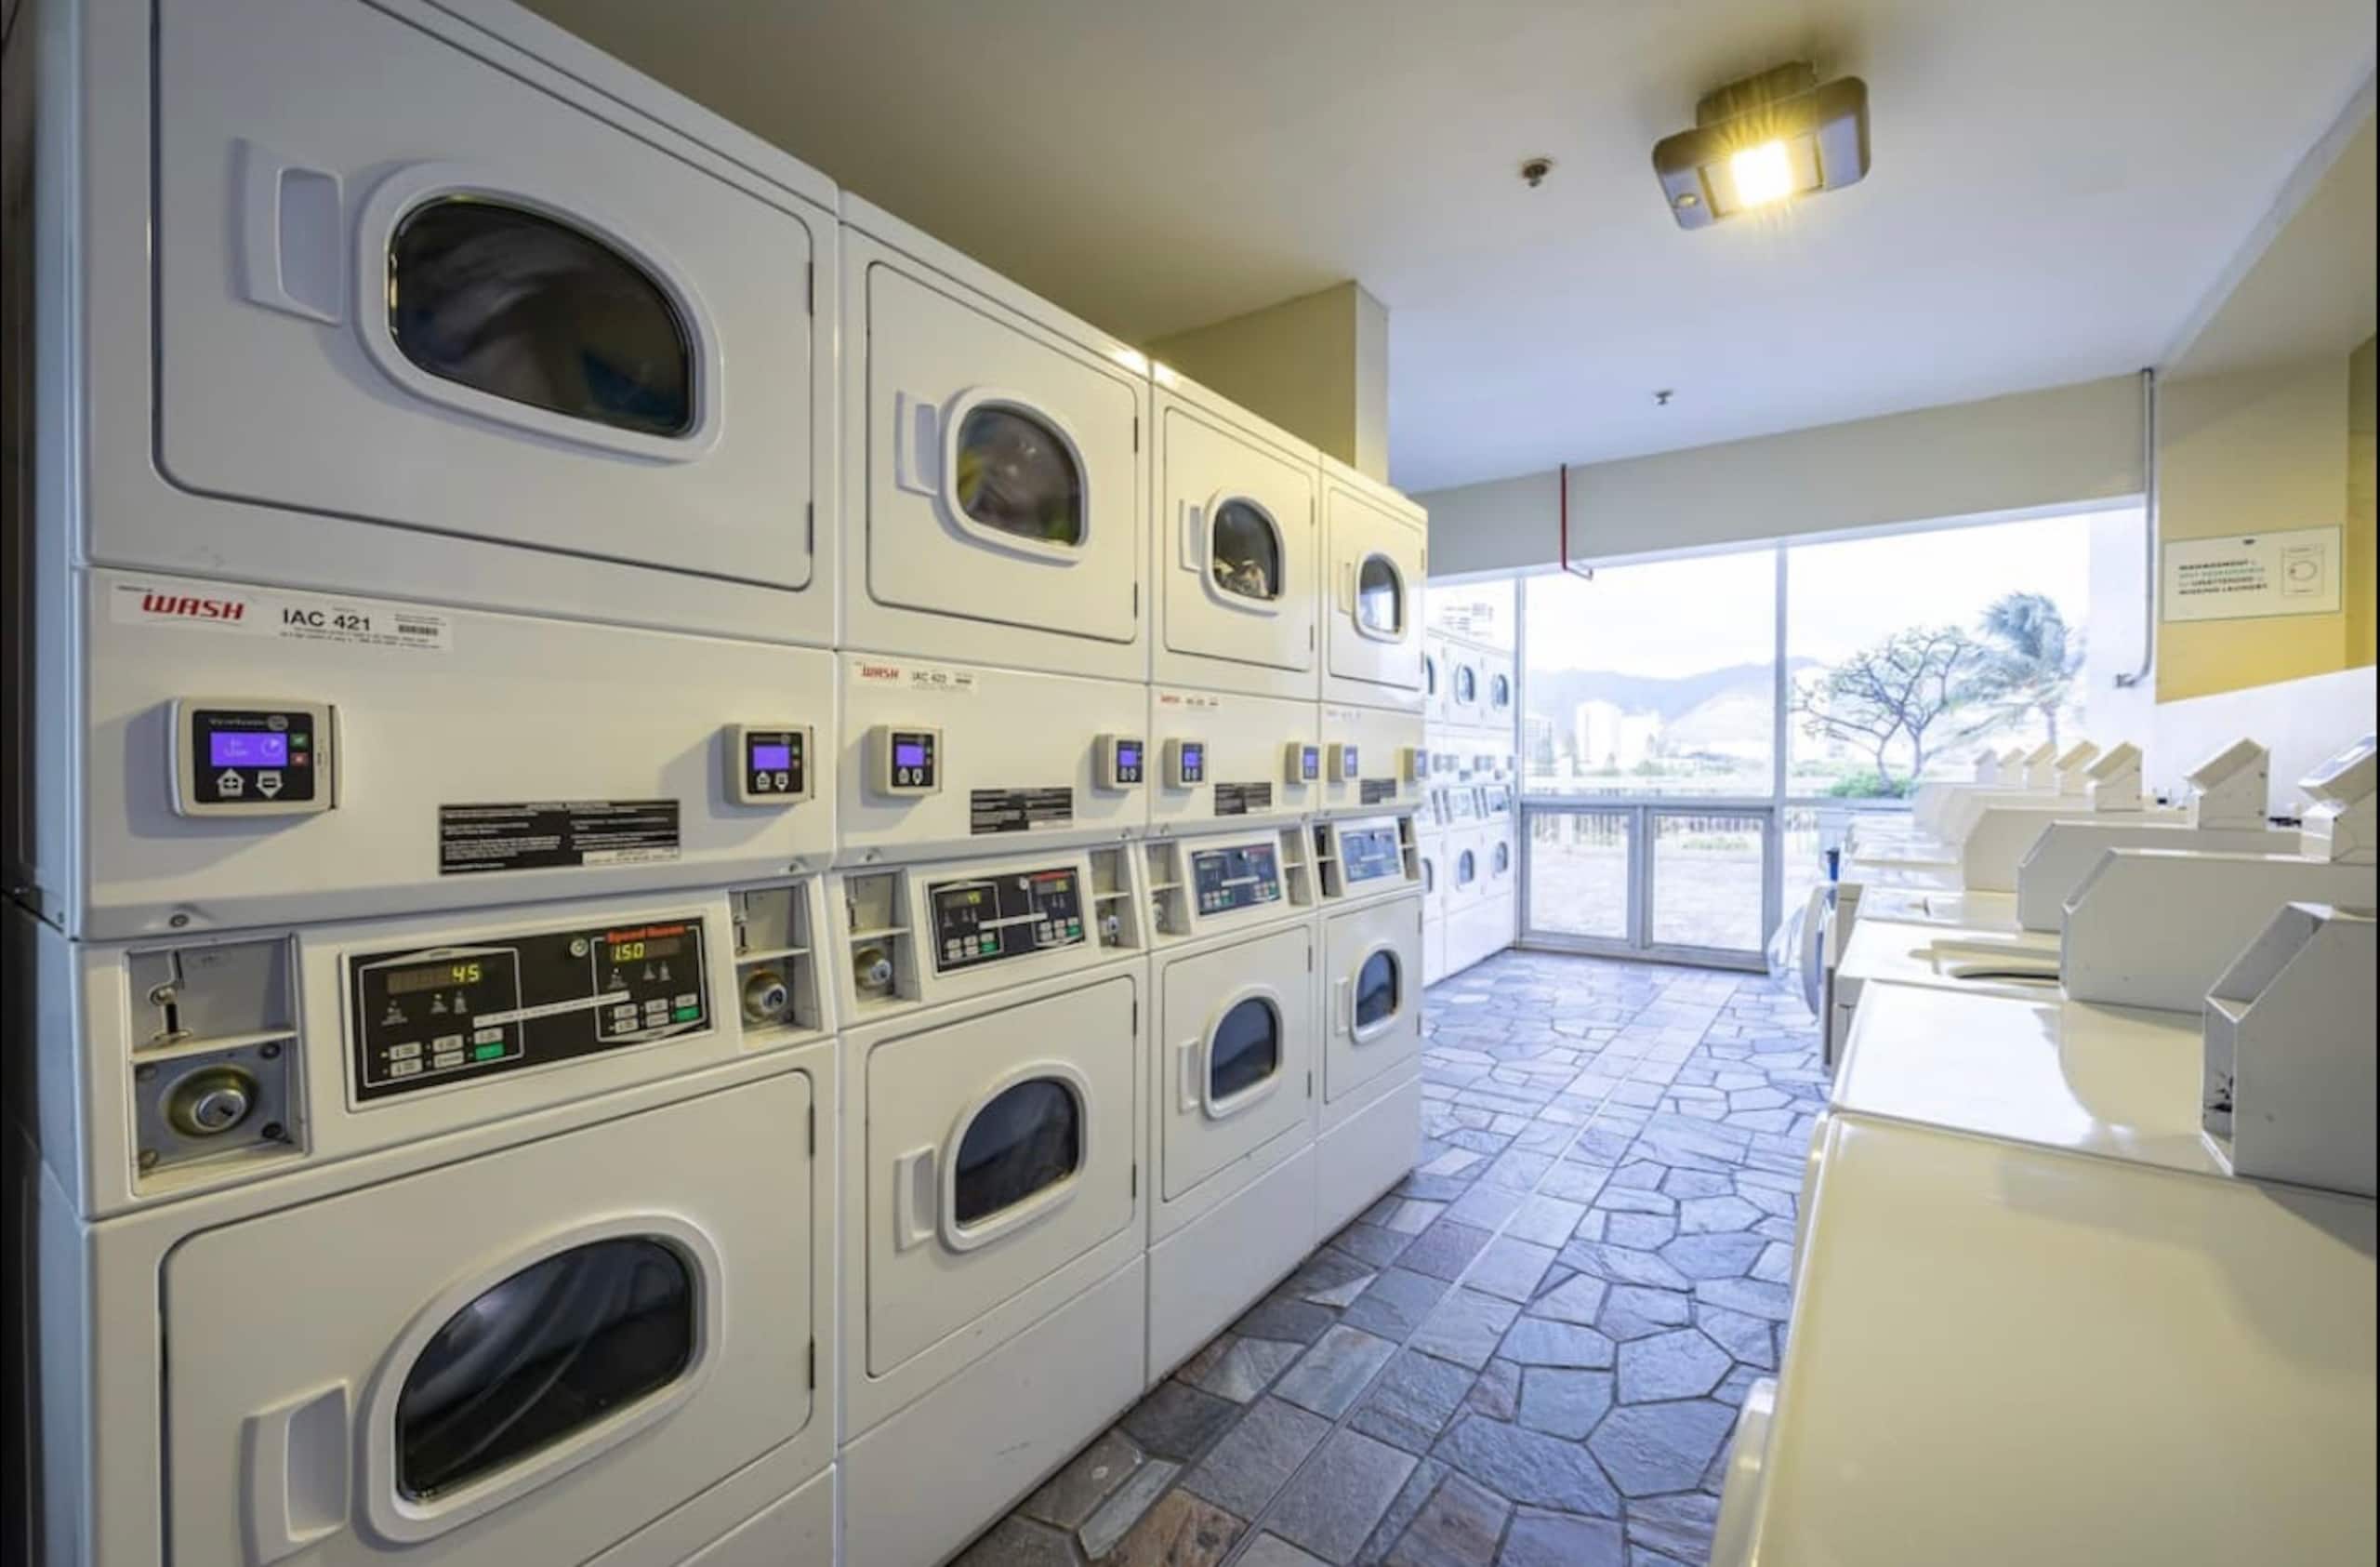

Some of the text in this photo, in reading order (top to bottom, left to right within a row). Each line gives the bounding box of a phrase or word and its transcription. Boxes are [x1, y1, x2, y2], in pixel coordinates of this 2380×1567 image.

[142, 594, 245, 620] WASH
[283, 607, 370, 631] IAC 421
[452, 964, 480, 983] 45
